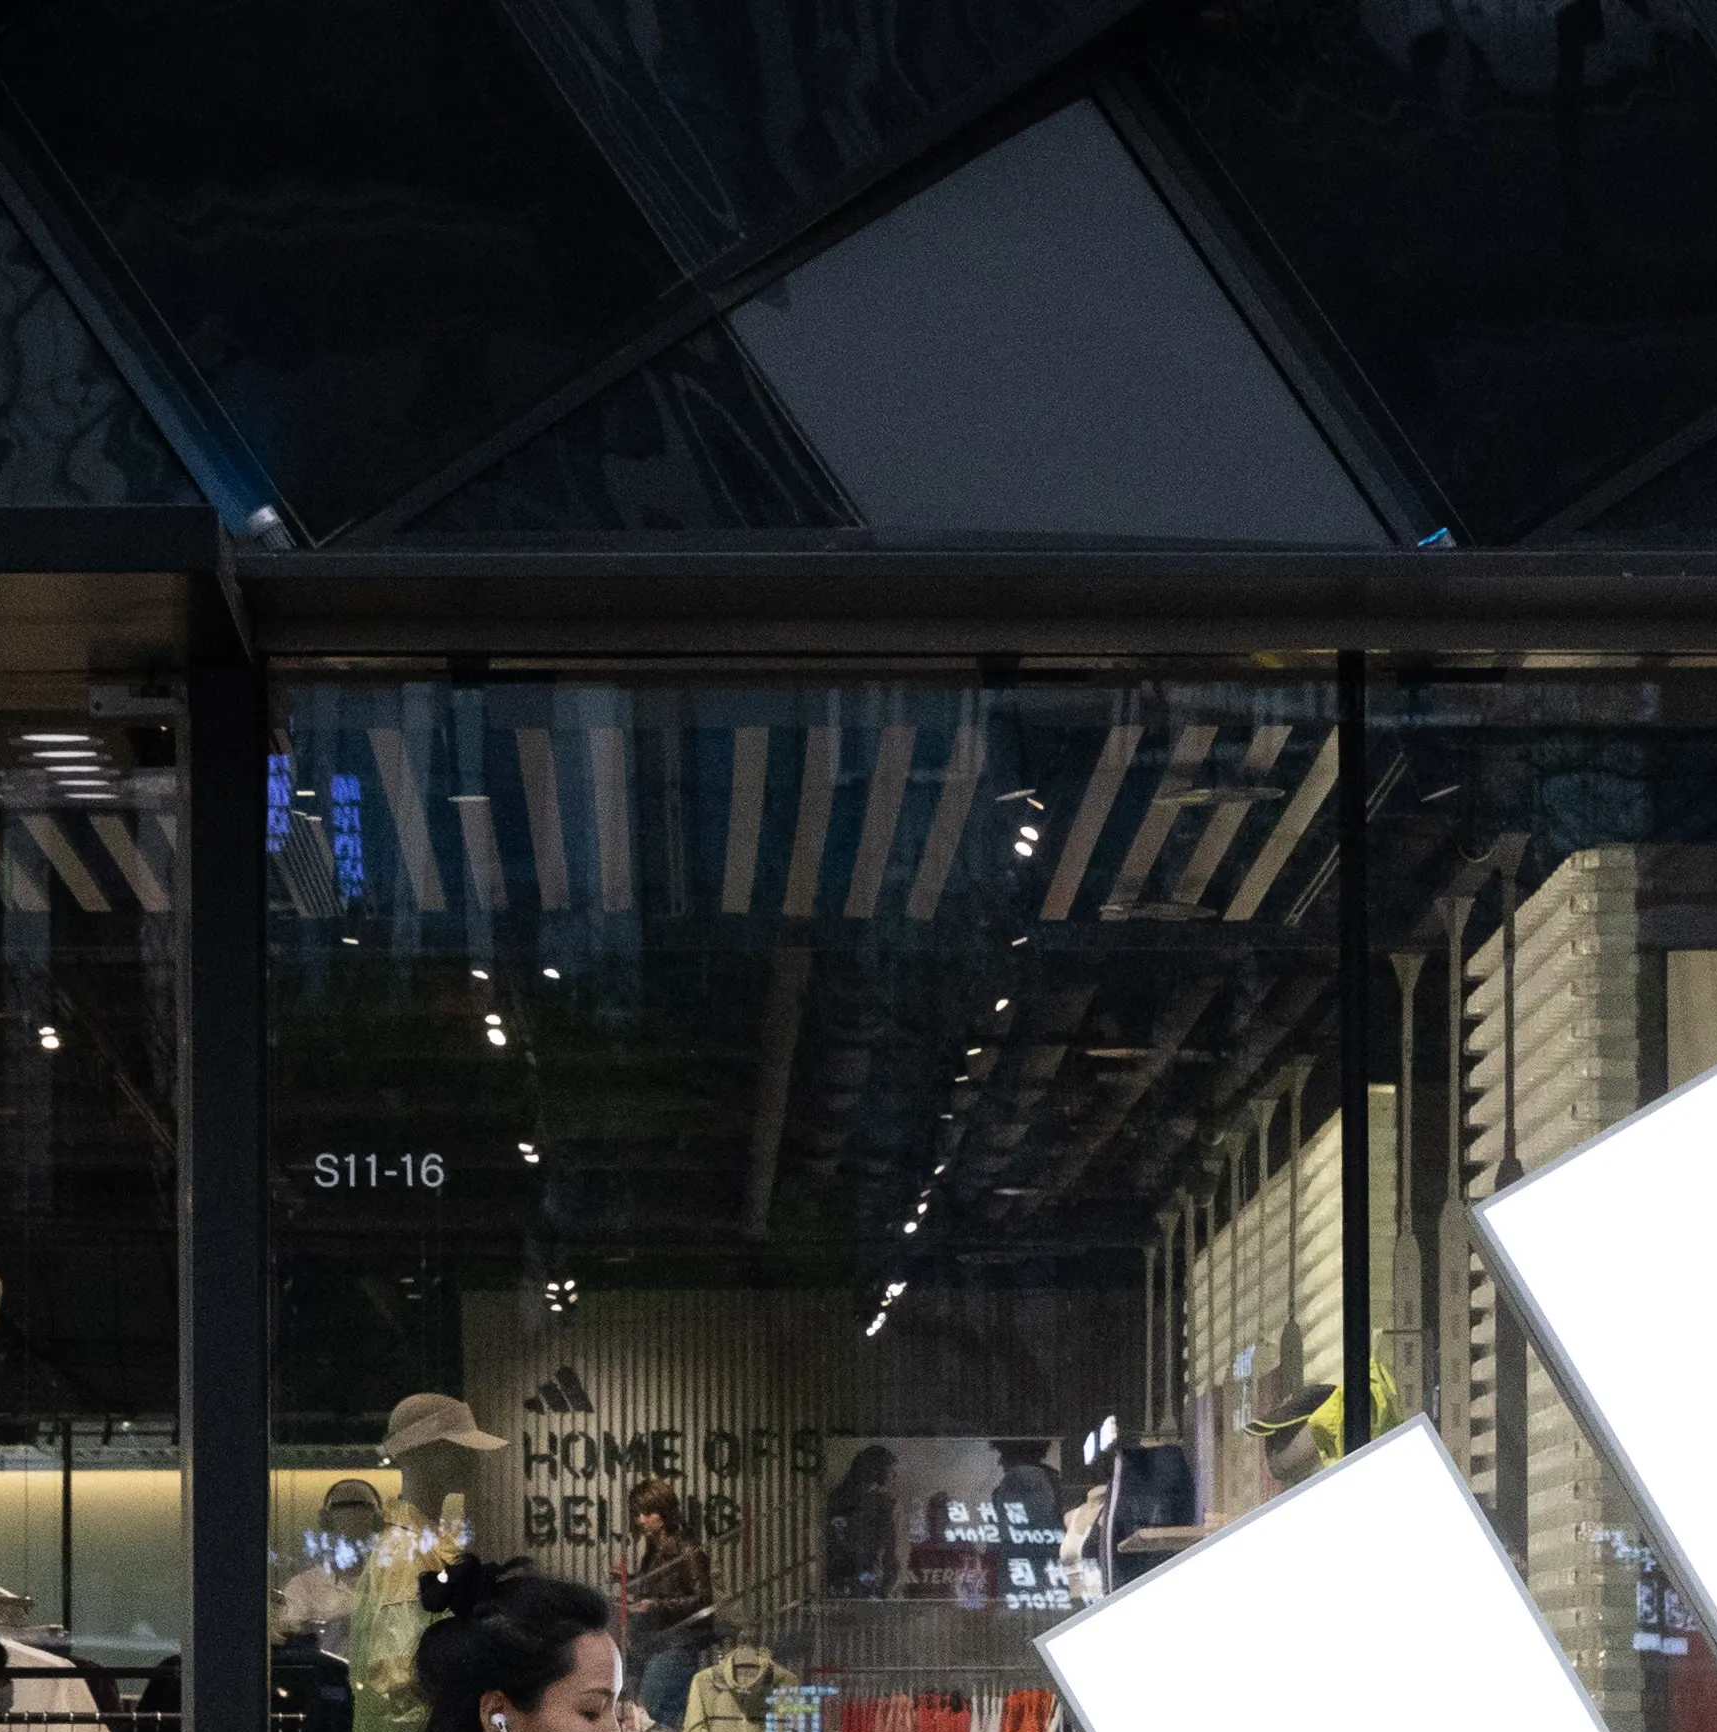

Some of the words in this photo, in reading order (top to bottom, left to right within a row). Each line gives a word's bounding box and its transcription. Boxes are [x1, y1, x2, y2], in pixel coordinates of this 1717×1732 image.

[313, 1152, 445, 1188] S11-16
[523, 1430, 685, 1480] HOME
[704, 1430, 782, 1480] OF
[524, 1495, 739, 1547] BEING
